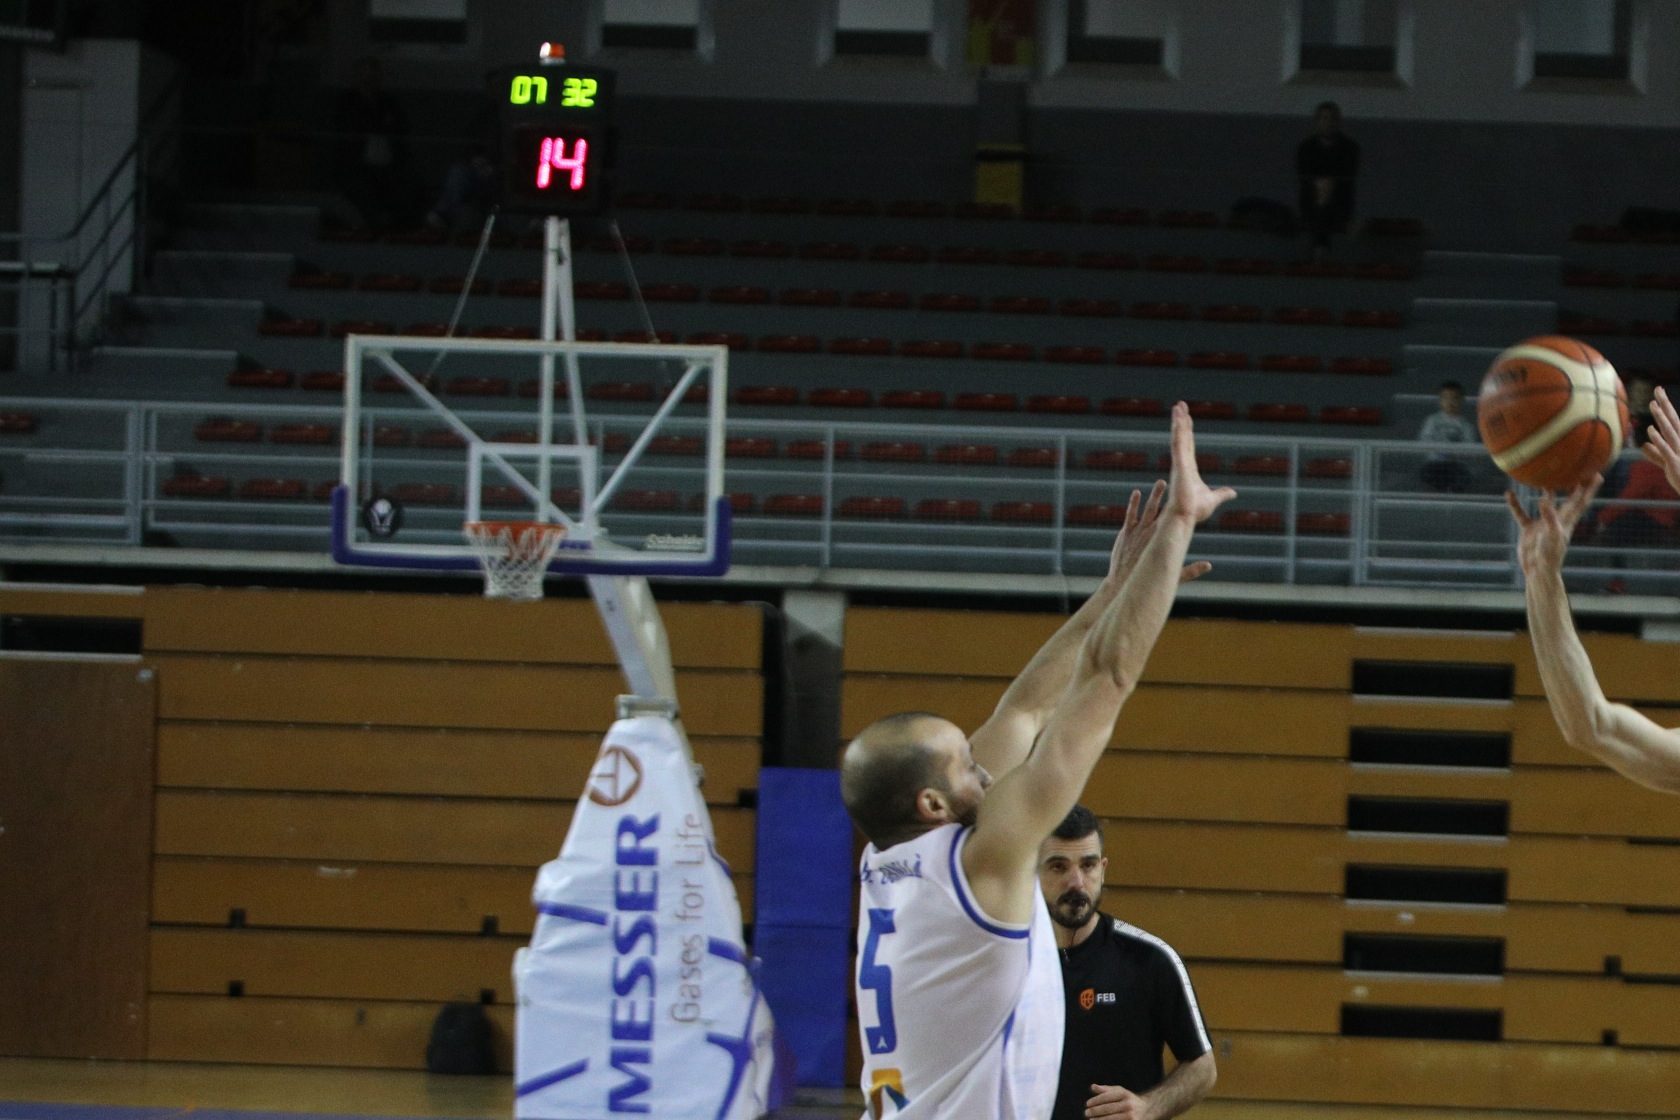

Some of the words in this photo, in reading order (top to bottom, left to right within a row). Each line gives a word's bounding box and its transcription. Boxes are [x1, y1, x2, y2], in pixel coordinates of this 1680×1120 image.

[510, 75, 548, 105] 07
[561, 77, 598, 108] 32
[536, 137, 587, 190] 14
[675, 812, 705, 866] Life
[676, 883, 704, 922] for
[608, 813, 660, 1114] MESSER
[670, 934, 702, 1025] Gases
[858, 908, 898, 1055] 5
[1096, 992, 1116, 1003] FEB
